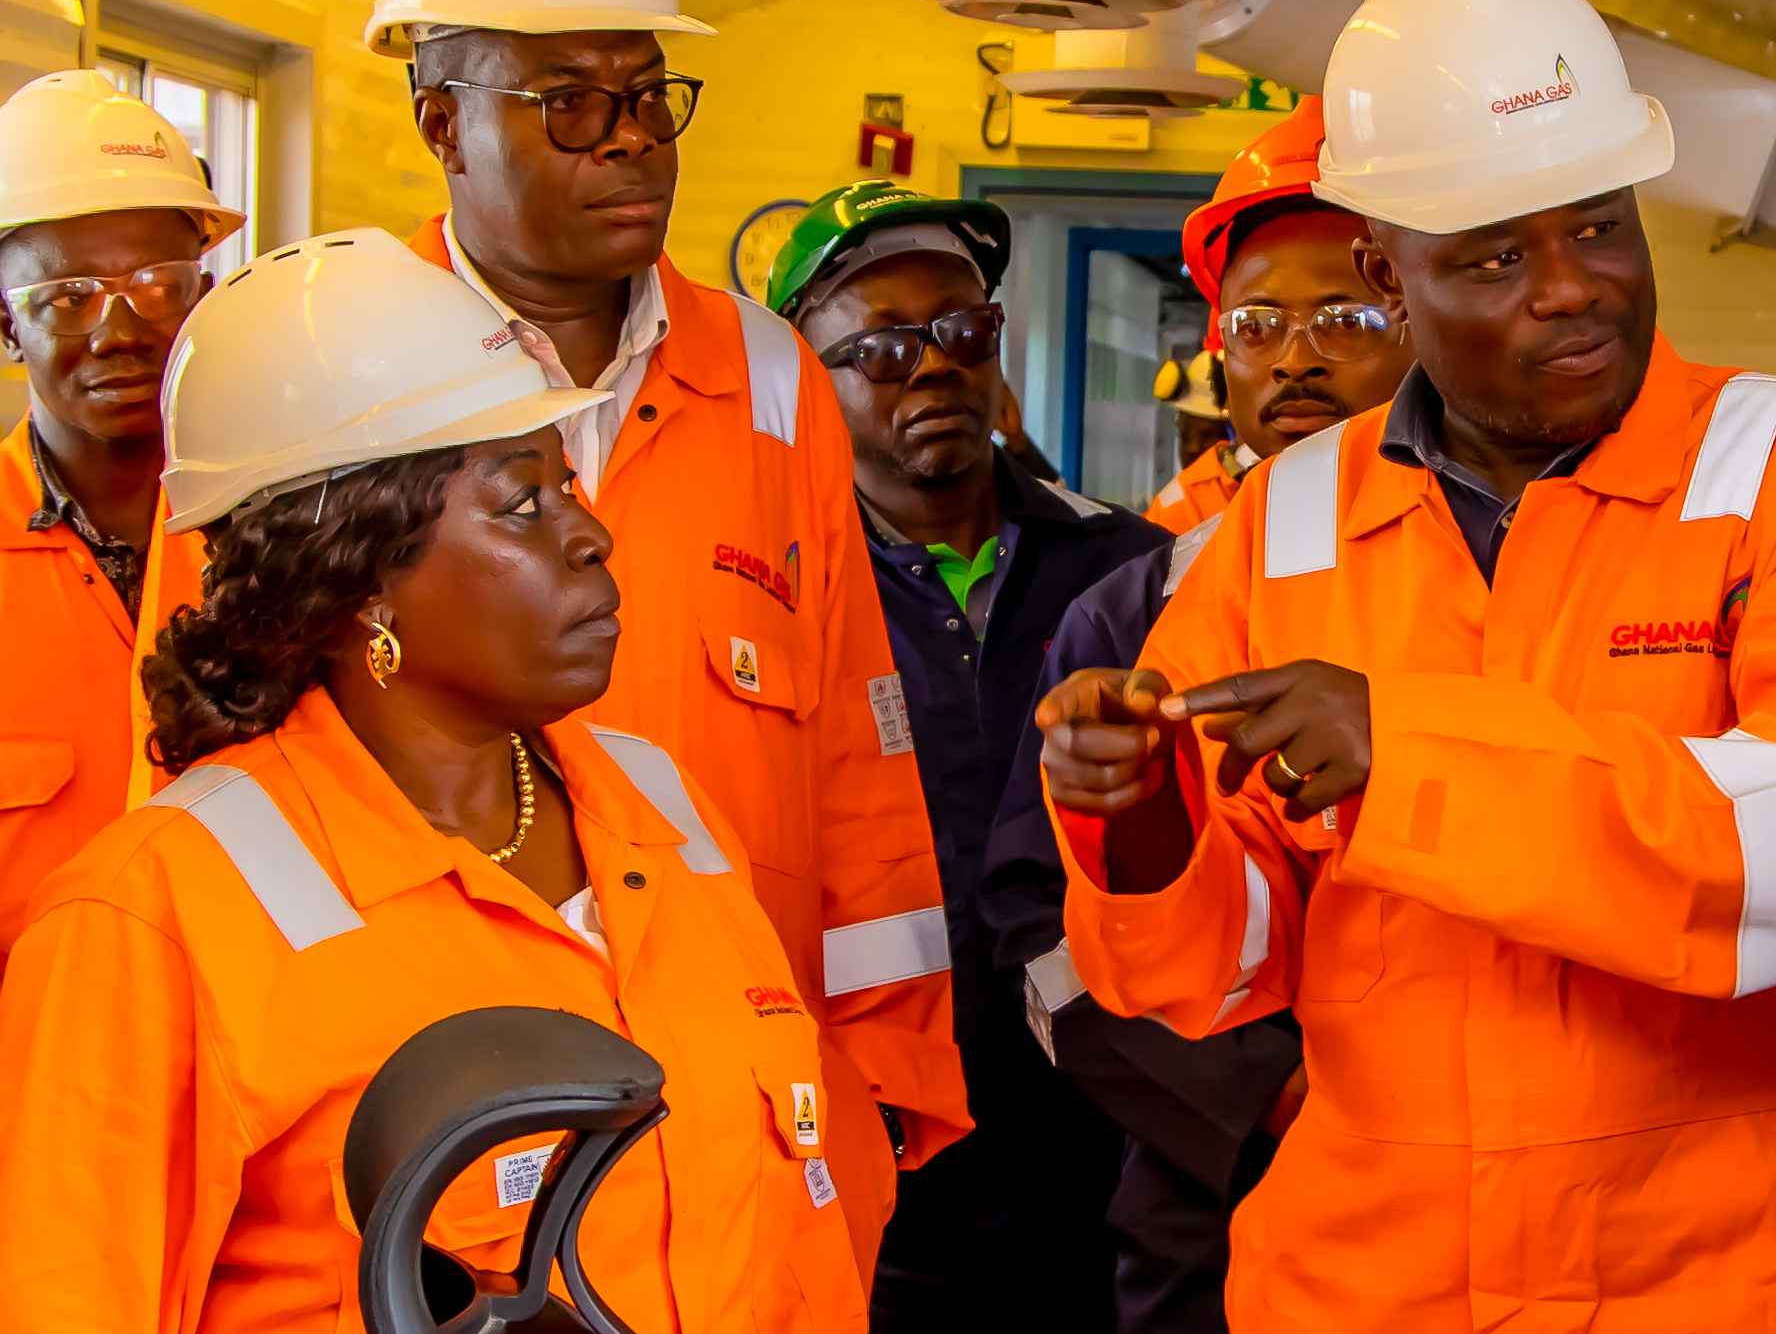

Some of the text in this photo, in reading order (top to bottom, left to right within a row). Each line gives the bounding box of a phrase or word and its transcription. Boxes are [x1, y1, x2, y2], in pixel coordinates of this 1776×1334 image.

[1491, 89, 1545, 113] GHANA
[1545, 82, 1572, 99] GAS
[1610, 620, 1715, 647] GHANA
[508, 1155, 533, 1167] PRIME
